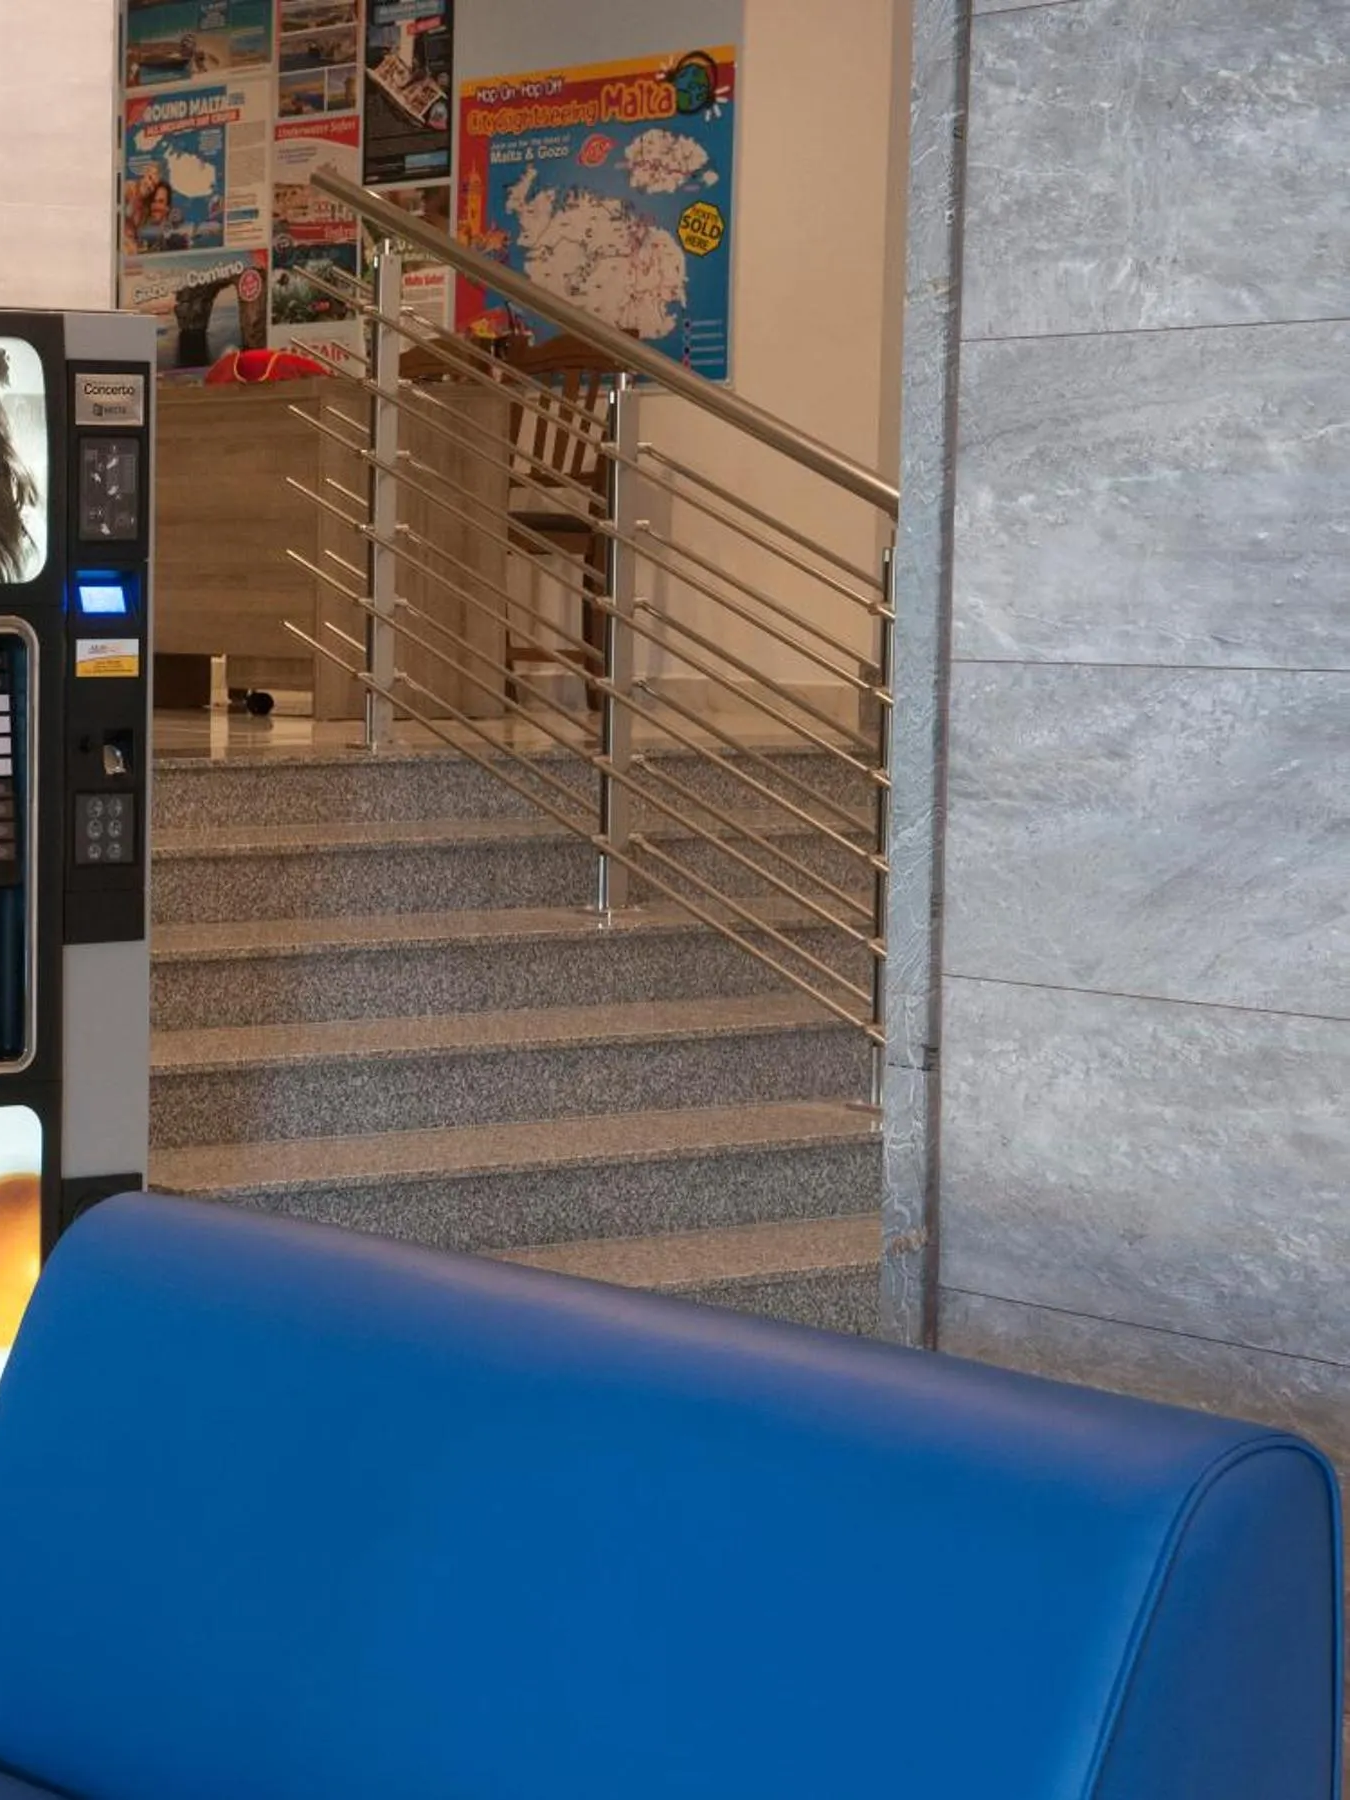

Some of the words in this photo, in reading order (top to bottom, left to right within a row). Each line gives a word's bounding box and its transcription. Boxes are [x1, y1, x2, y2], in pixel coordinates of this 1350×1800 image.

[601, 81, 677, 123] Malta
[682, 214, 721, 239] SOLD
[187, 260, 244, 287] Comino
[84, 382, 135, 395] Concerto
